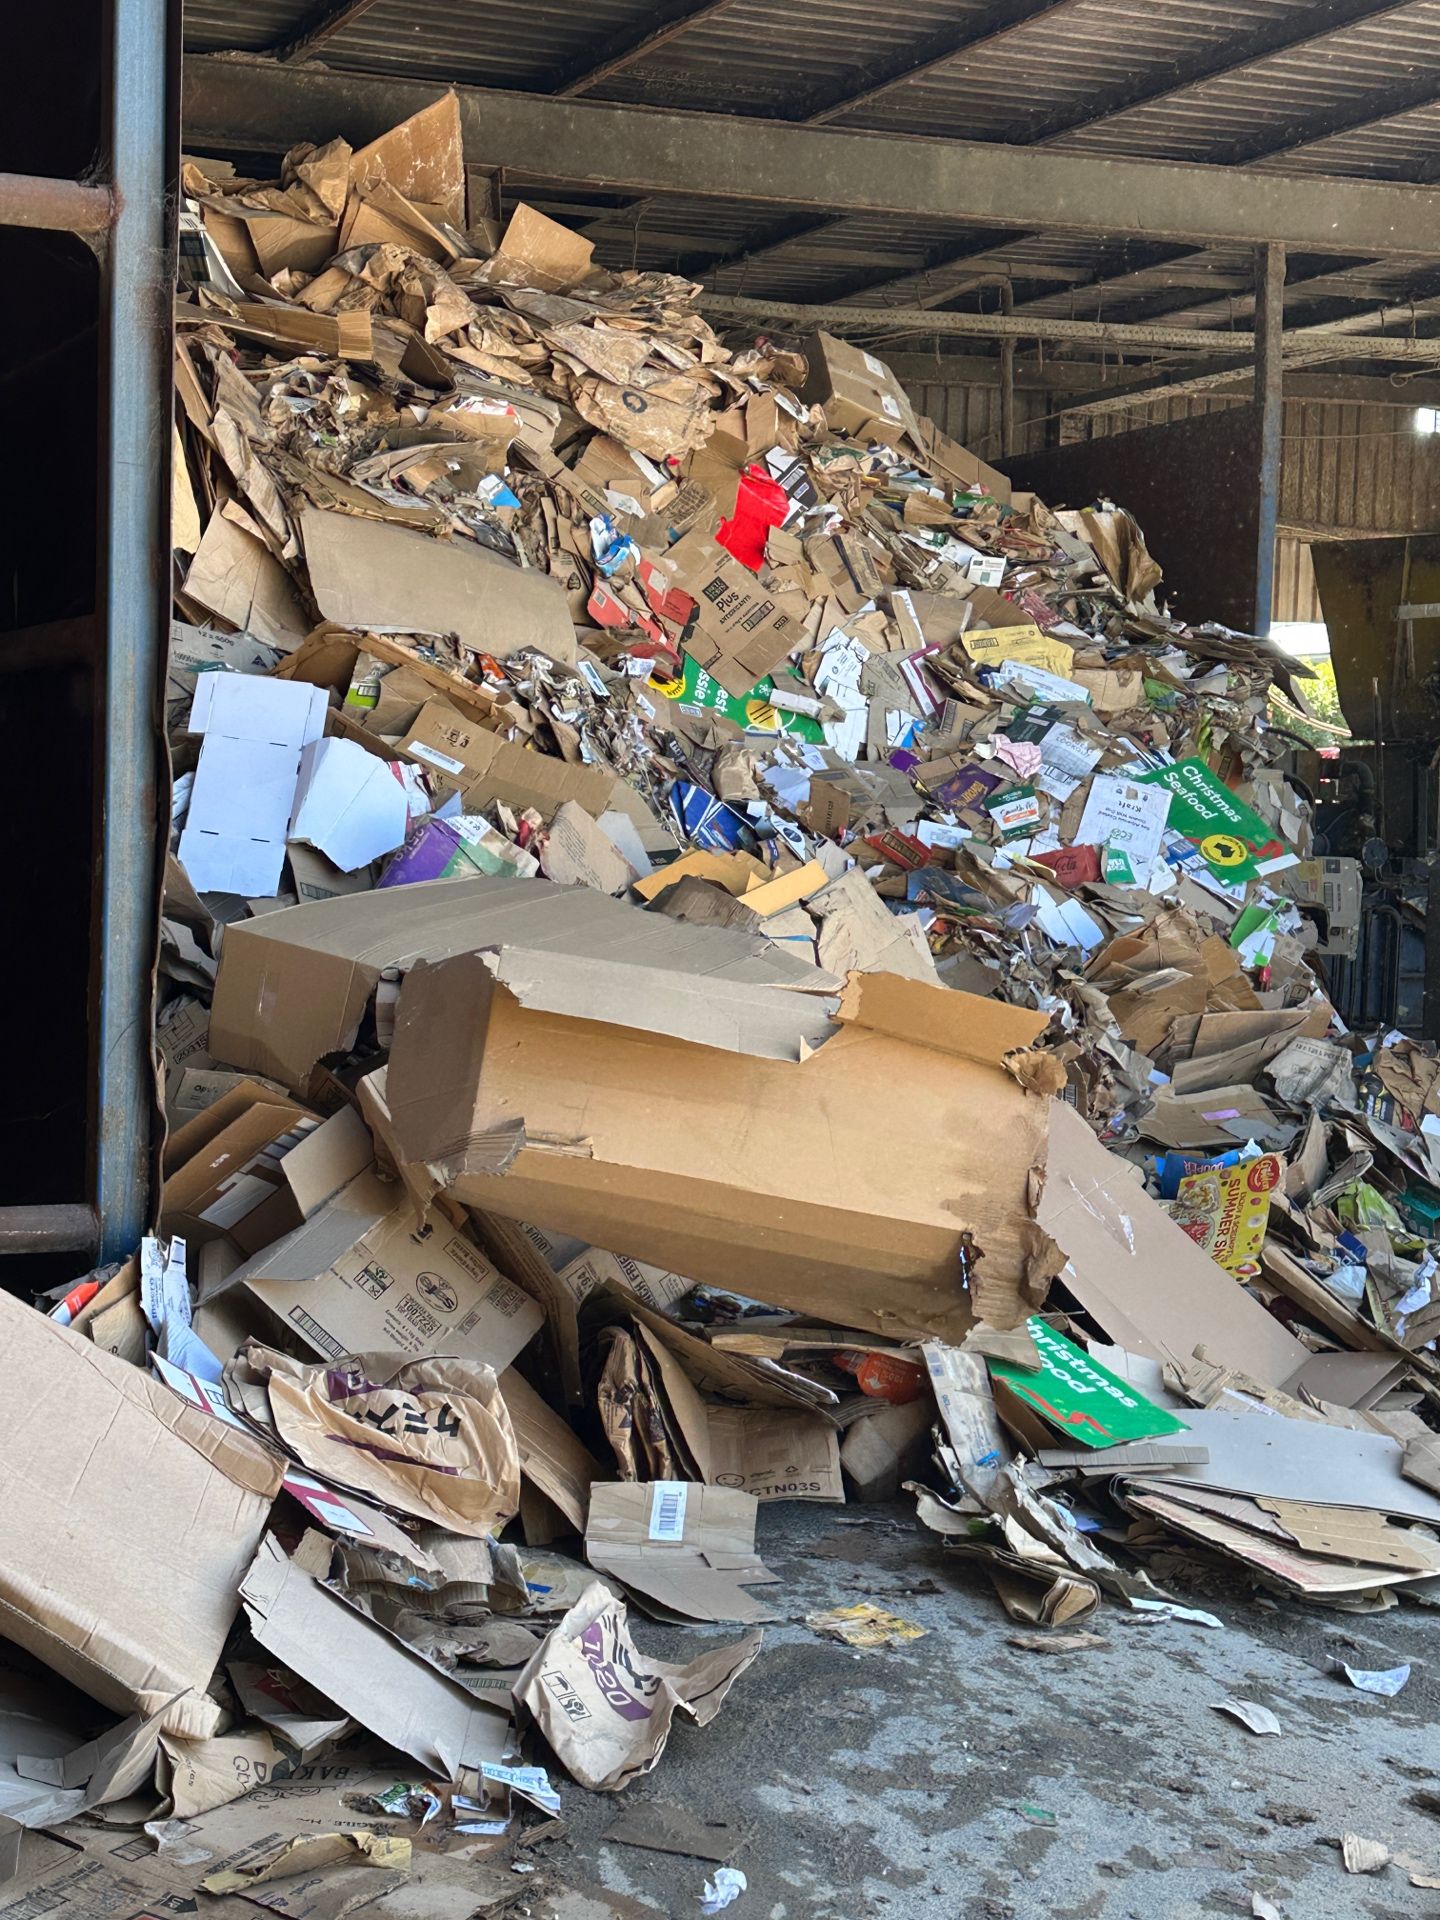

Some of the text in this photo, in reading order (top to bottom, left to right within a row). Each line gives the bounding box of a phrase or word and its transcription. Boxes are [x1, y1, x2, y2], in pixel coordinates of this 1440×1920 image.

[716, 591, 741, 613] Plus
[1163, 772, 1216, 820] Seafood
[1182, 764, 1243, 824] Christmas
[1217, 1178, 1240, 1236] SUMMER
